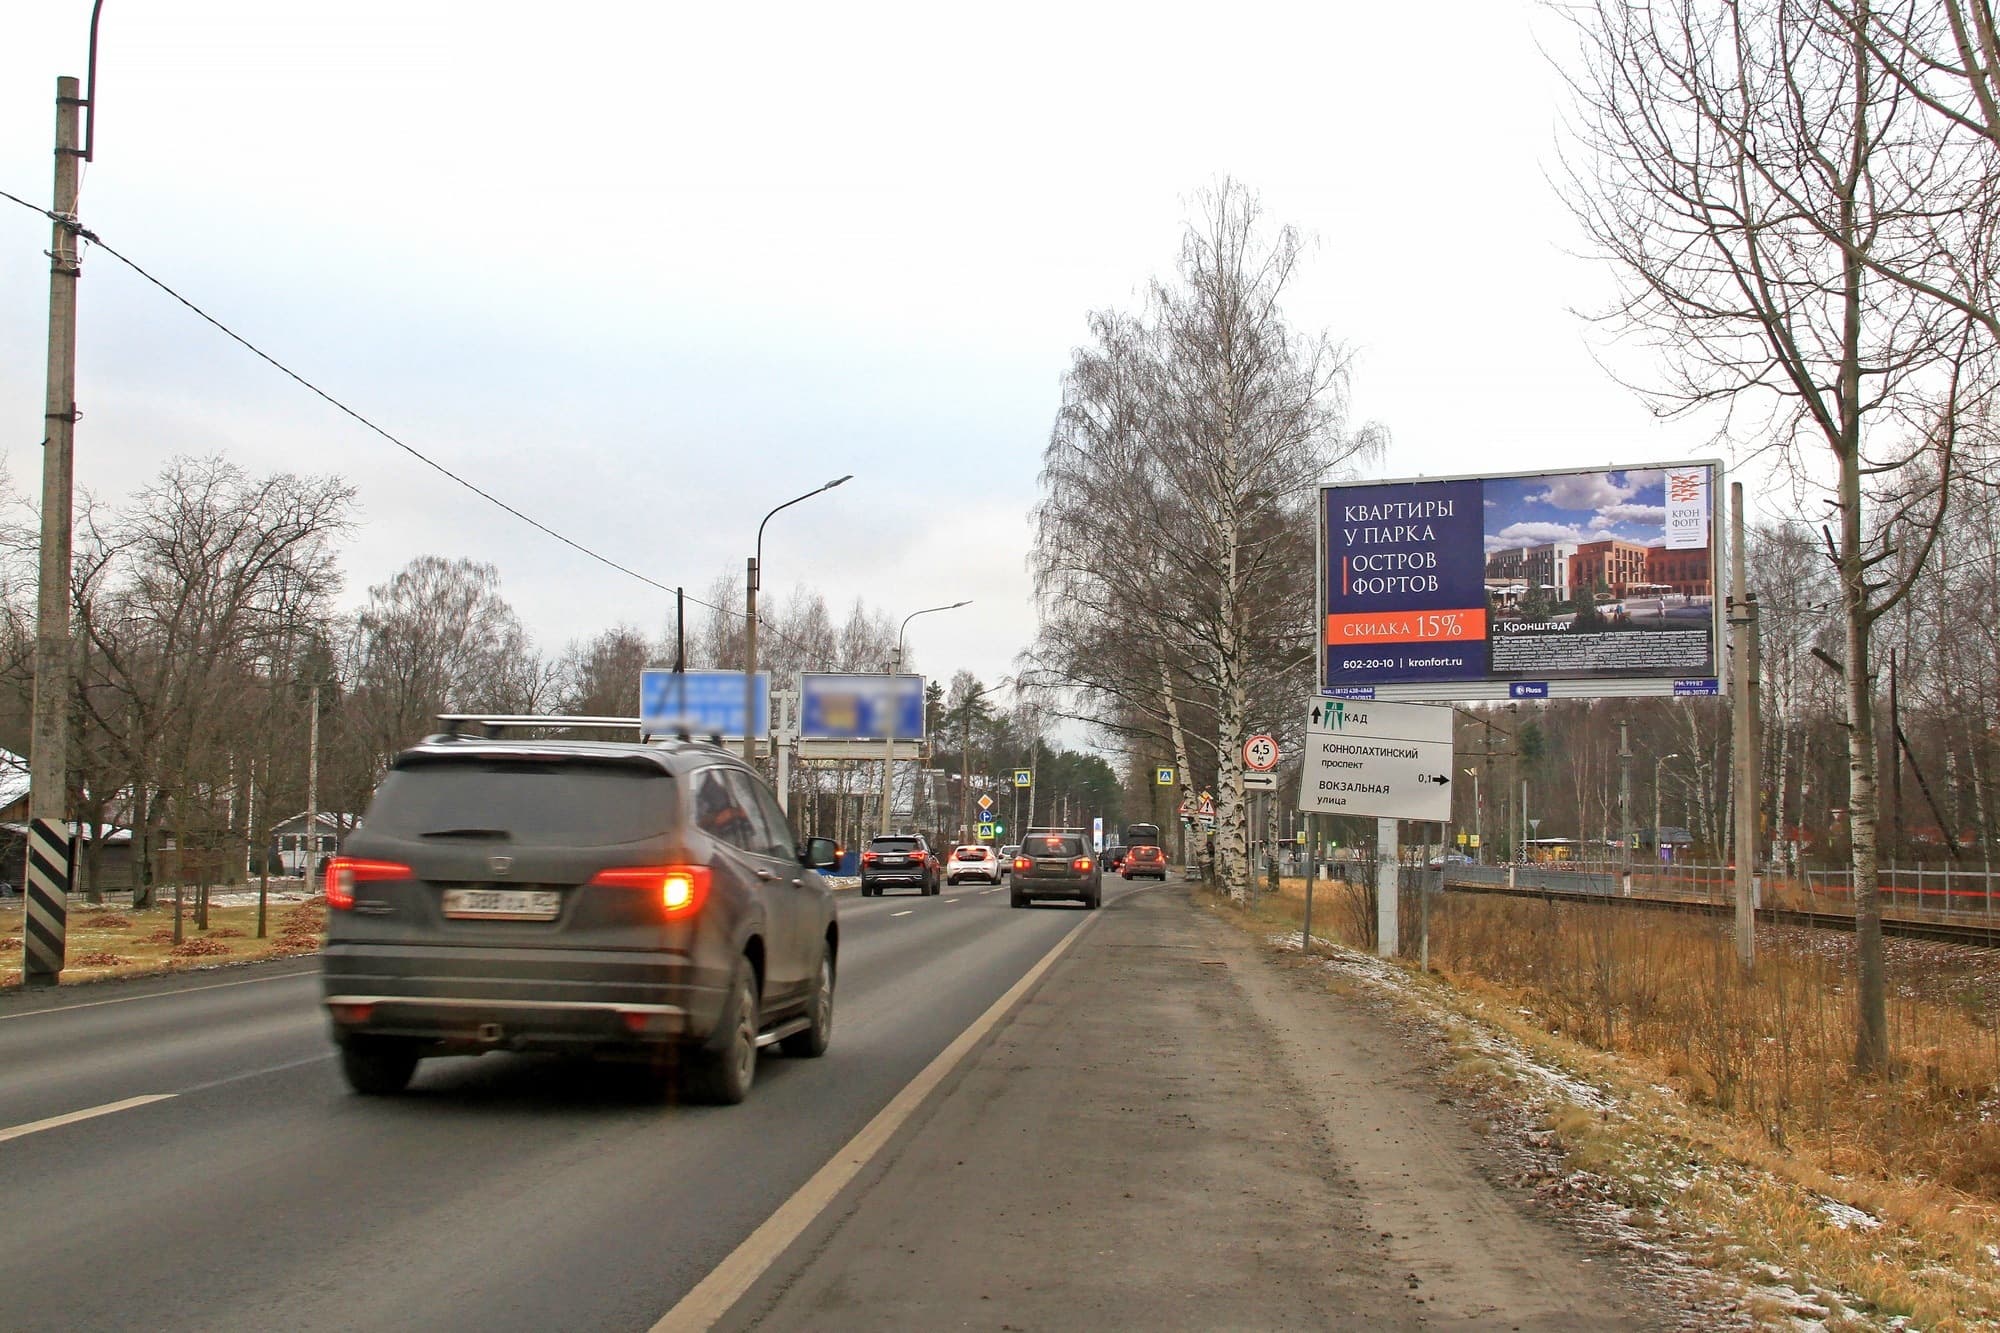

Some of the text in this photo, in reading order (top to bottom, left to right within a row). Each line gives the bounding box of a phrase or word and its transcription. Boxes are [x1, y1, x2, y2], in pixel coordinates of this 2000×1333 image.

[1344, 500, 1454, 522] КВАРТИРЫ
[1672, 509, 1699, 518] КРОН
[1672, 518, 1700, 527] ФОРТ
[1344, 525, 1436, 546] У ПАРКА
[1352, 552, 1437, 572] ОСТРОВ
[1352, 575, 1439, 595] ФОРТОВ
[1343, 623, 1411, 636] СКИДКА
[1492, 621, 1572, 633] г. Кронштадт
[1343, 658, 1462, 669] 602-20-10 kronfort.ru
[1525, 686, 1542, 694] Russ
[1344, 713, 1368, 724] КАД
[1322, 743, 1419, 760] КОННОЛАХТИНСКИЙ
[1321, 759, 1363, 769] проспект
[1418, 773, 1432, 784] 0,1
[1319, 780, 1390, 795] ВОКЗАЛЬНАЯ
[1317, 796, 1347, 806] улица
